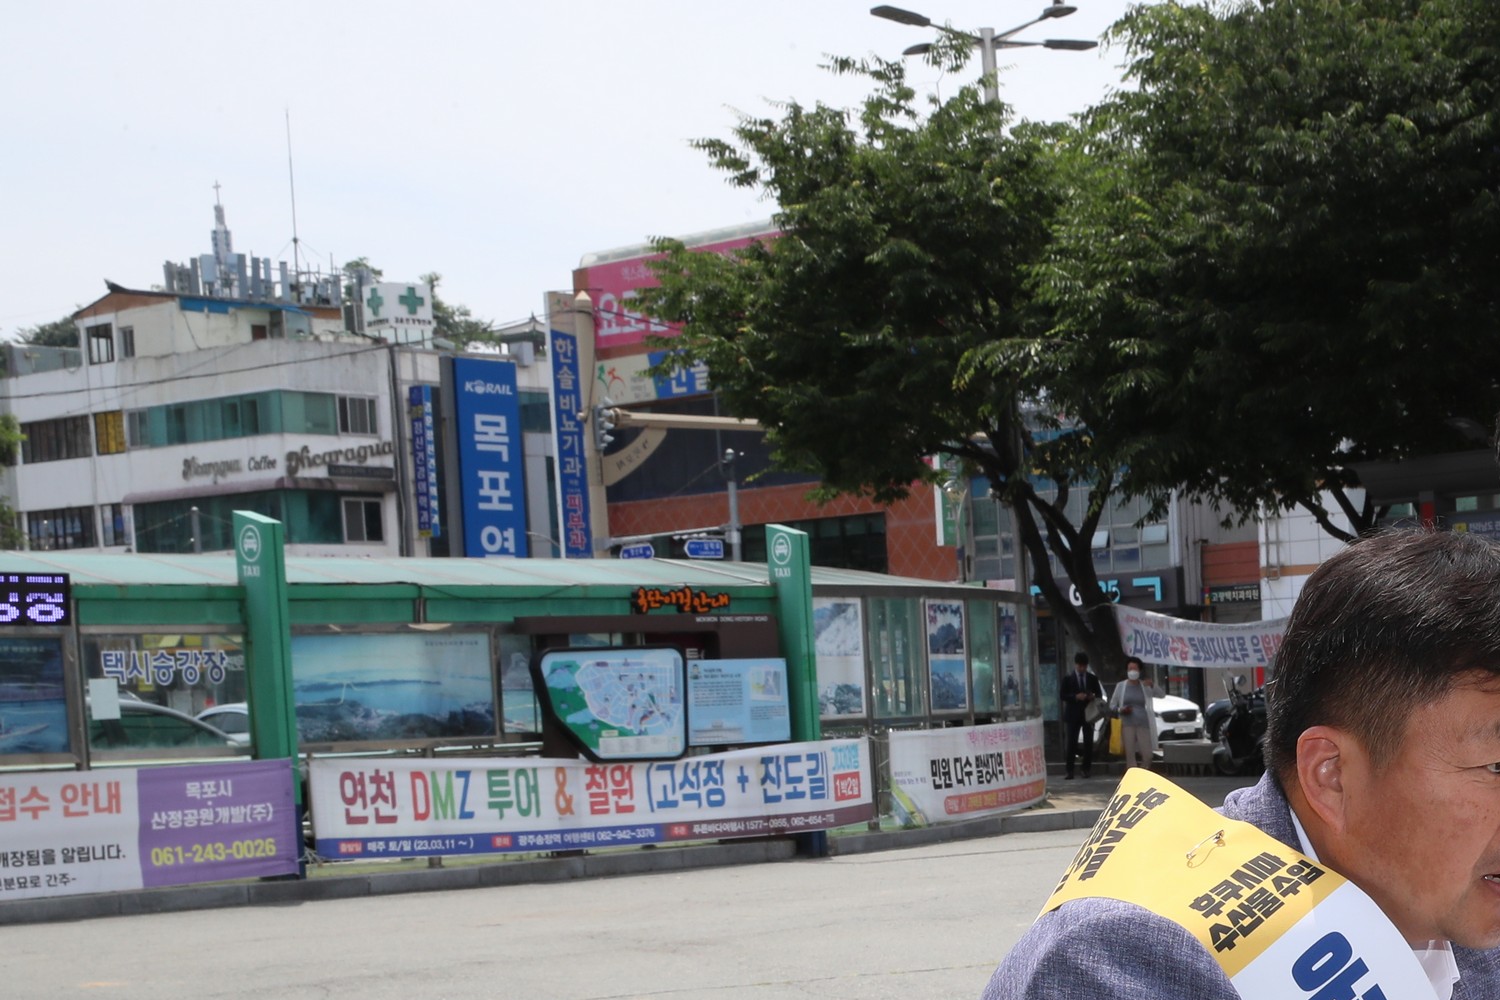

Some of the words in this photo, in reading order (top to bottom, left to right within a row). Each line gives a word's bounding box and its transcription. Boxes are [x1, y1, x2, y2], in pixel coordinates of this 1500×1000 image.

[465, 380, 513, 395] KORAIL
[554, 338, 582, 478] 한솔비뇨기과
[247, 456, 277, 471] Coffee
[286, 440, 394, 476] Nicaragua
[474, 414, 517, 558] 목포역
[567, 495, 586, 550] 피부과
[242, 565, 261, 577] TAXI
[773, 568, 791, 578] TAXI
[101, 650, 228, 686] 택시승강장
[930, 757, 953, 790] 민원
[953, 756, 973, 787] 다수
[60, 781, 121, 818] 안내
[186, 779, 232, 799] 목포시
[339, 769, 398, 825] 연천
[410, 770, 475, 822] DMZ
[487, 767, 542, 820] 투어
[555, 767, 575, 816] &
[584, 764, 636, 815] 철원
[737, 765, 749, 793] +
[151, 803, 274, 830] 산정공원개발(주)
[518, 834, 561, 847] 광주송정역
[1078, 787, 1170, 881] 후쿠시마
[61, 844, 127, 865] 알립니다.
[151, 838, 276, 867] 061-243-0026
[0, 875, 41, 892] 분묘로
[1188, 851, 1288, 919] 후쿠시마
